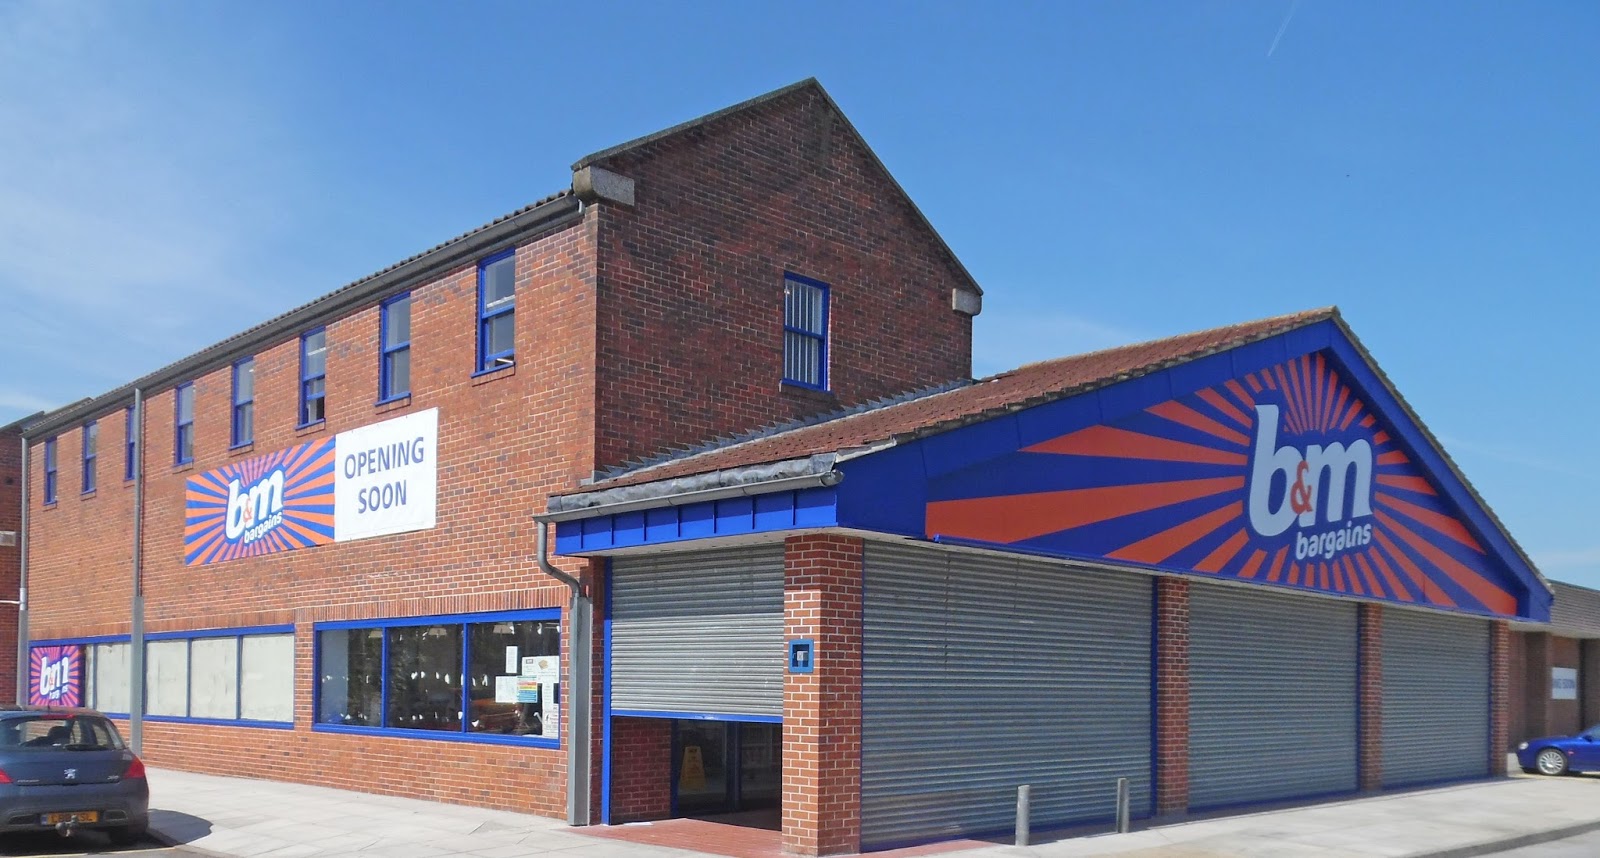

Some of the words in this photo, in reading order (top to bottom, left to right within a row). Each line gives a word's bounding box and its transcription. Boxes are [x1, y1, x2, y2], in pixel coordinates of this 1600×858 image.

[344, 436, 424, 479] OPENING
[358, 479, 407, 514] SOON
[244, 511, 283, 544] bargains
[1296, 520, 1372, 560] bargains
